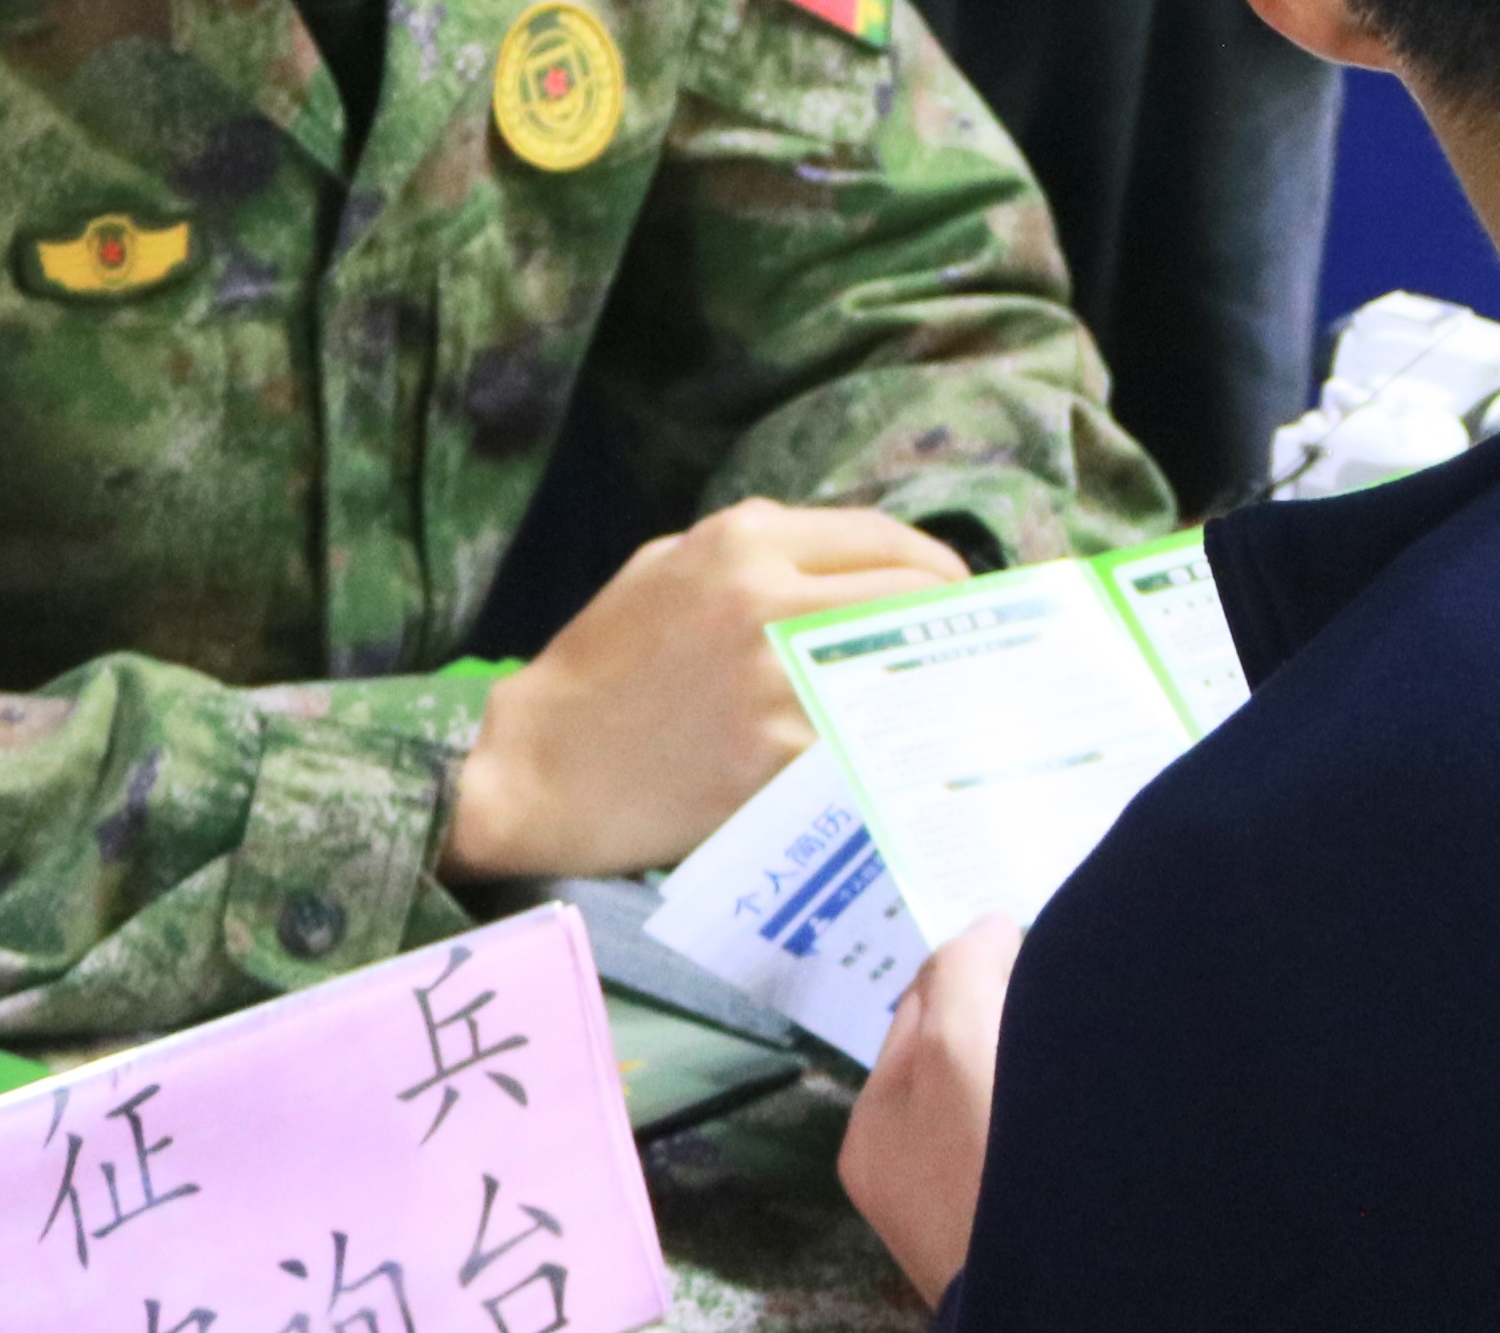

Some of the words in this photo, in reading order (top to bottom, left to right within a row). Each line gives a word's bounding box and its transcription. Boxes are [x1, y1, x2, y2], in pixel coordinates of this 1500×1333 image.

[734, 805, 852, 916] 个人简历
[38, 944, 530, 1269] 征兵
[145, 1171, 568, 1333] 询台
